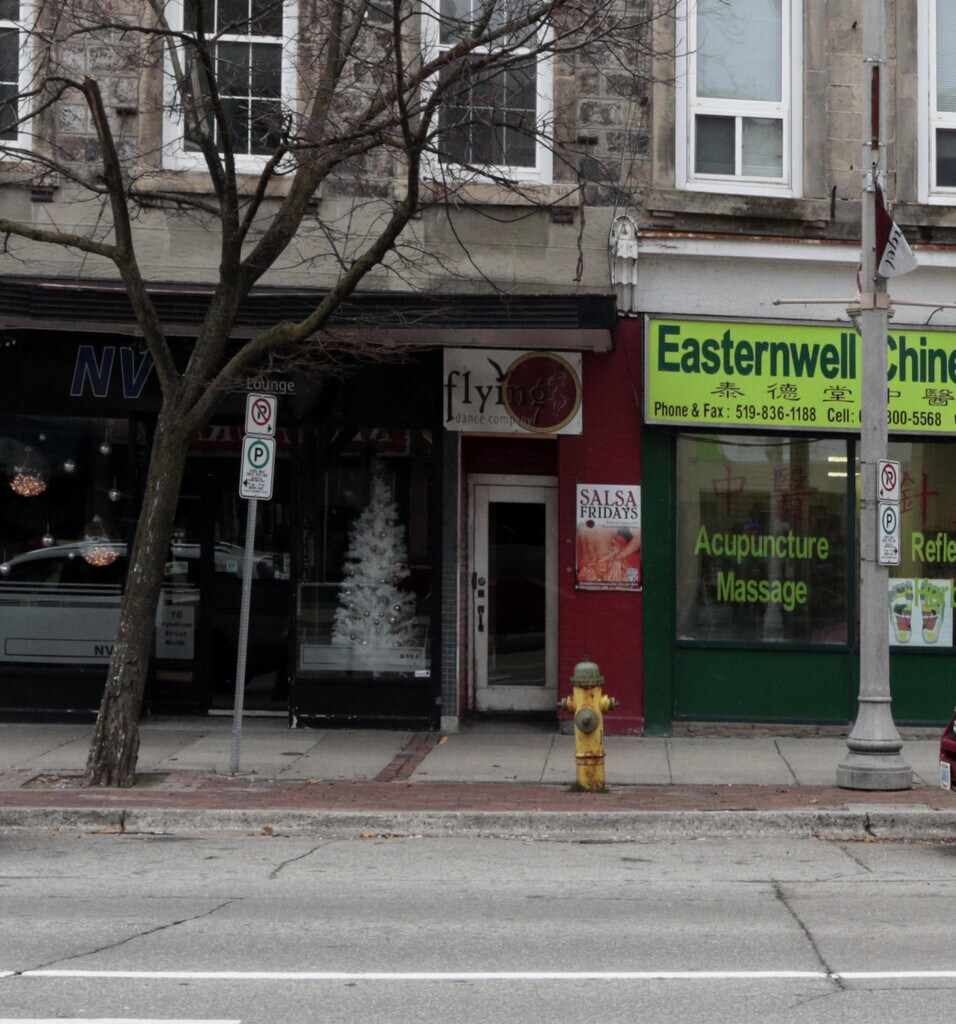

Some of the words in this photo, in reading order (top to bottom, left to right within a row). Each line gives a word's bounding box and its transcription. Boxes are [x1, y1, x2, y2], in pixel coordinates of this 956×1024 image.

[658, 325, 856, 379] Easternwell
[246, 379, 295, 392] Lounge
[455, 413, 485, 424] dance
[488, 415, 533, 427] company
[654, 402, 688, 418] Phone
[692, 404, 700, 418] &
[736, 404, 816, 422] 519-836-1188
[827, 408, 855, 423] Cell:
[580, 489, 637, 507] SALSA
[580, 506, 638, 520] FRIDAYS
[694, 525, 830, 564] Acupuncture
[717, 571, 808, 611] Massage
